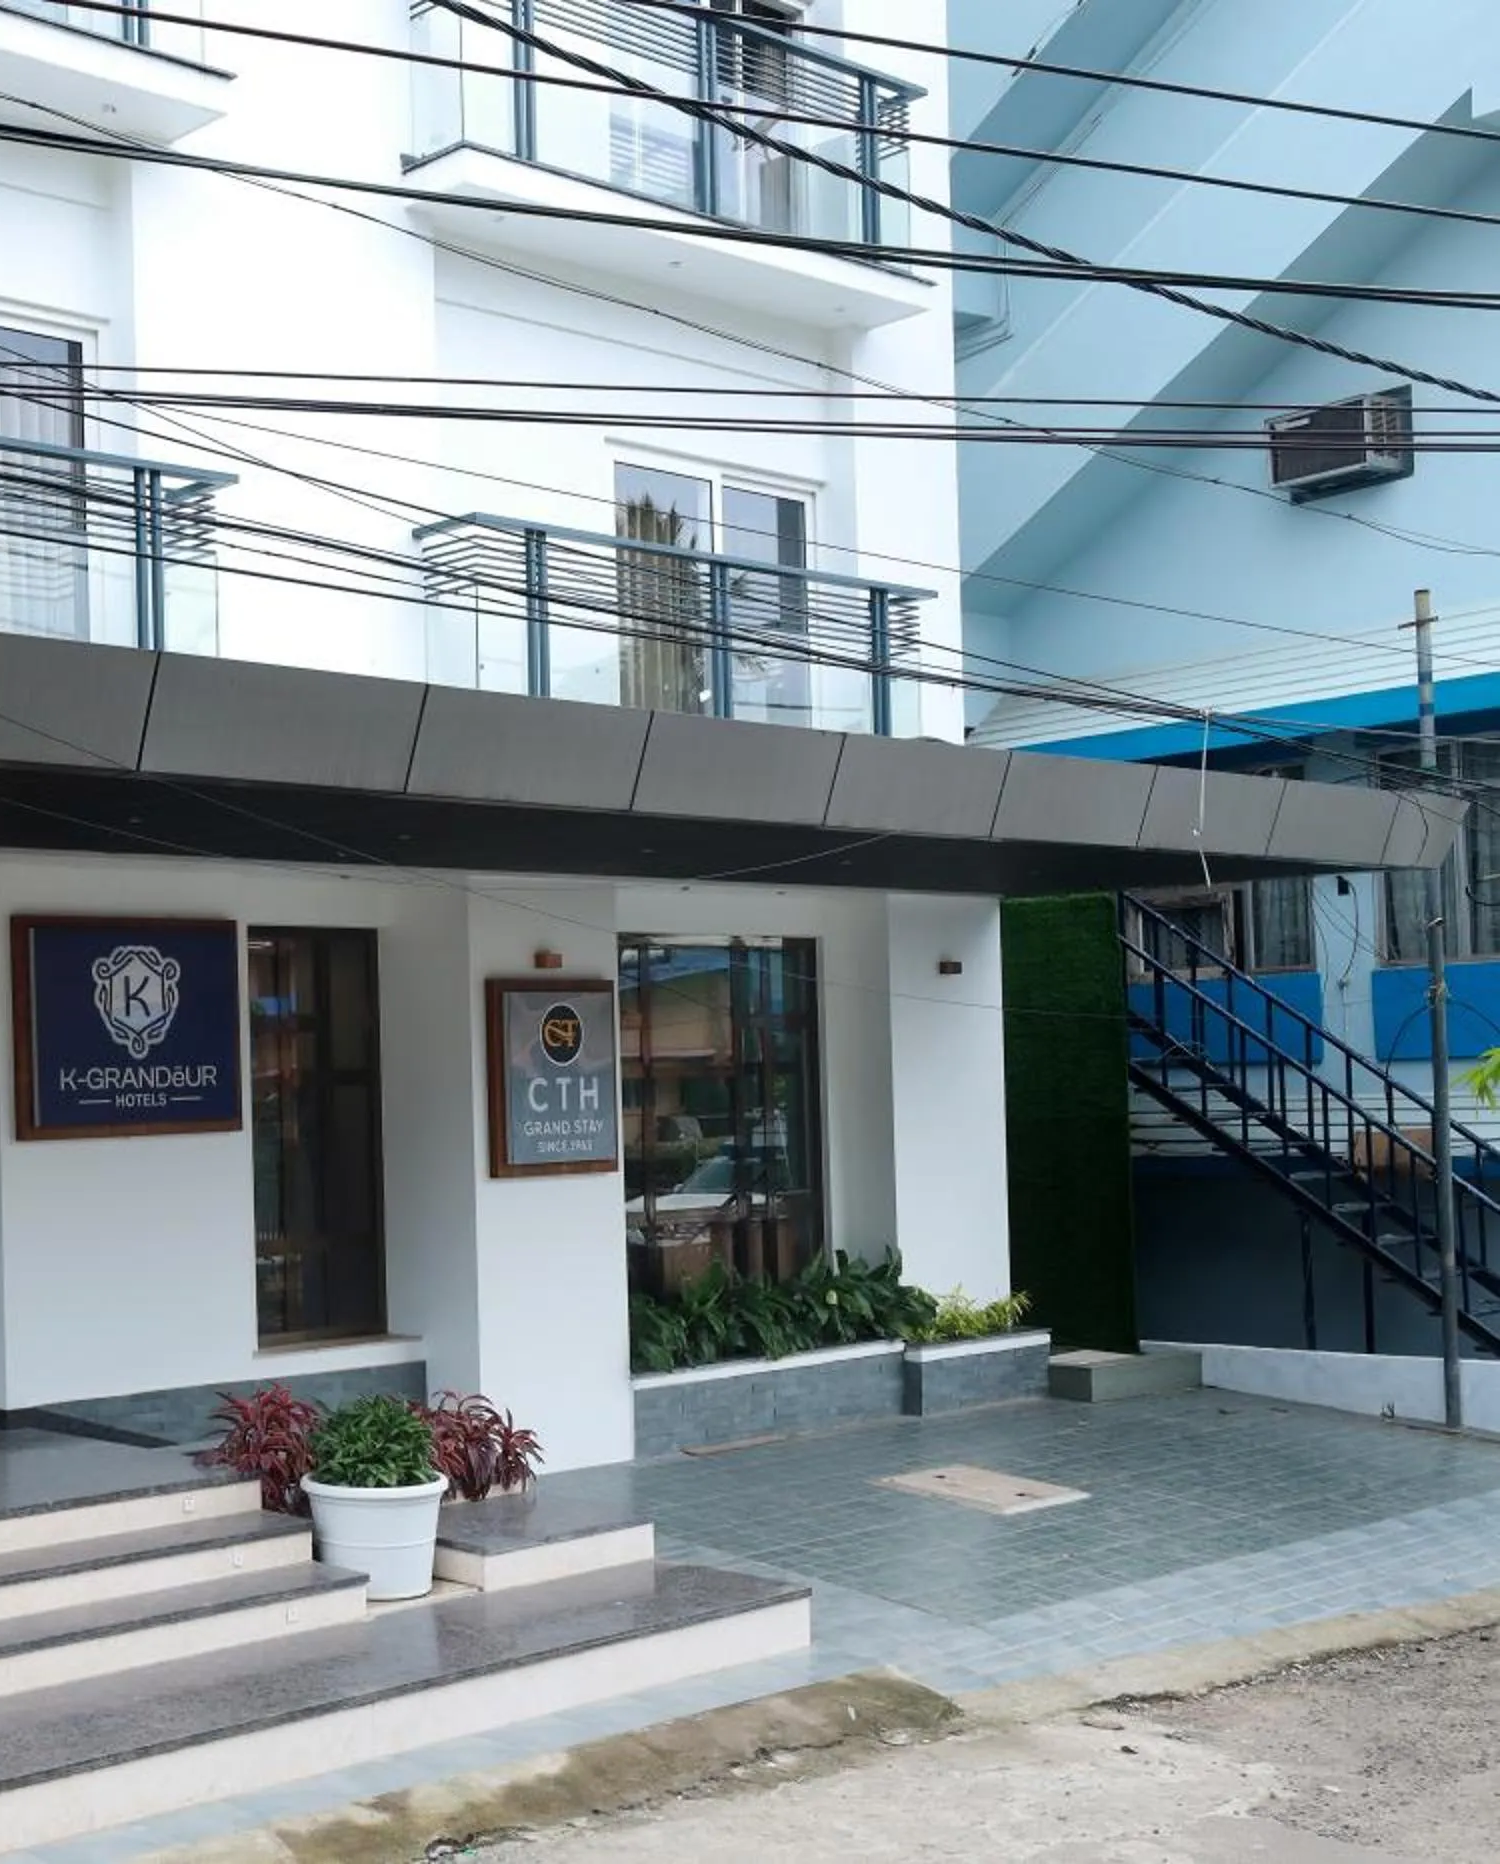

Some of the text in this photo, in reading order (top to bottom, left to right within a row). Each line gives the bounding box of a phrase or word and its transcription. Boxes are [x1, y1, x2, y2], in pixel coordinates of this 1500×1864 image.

[123, 975, 151, 1017] K
[115, 1092, 167, 1108] HOTELS
[523, 1118, 605, 1136] GRAND STAY
